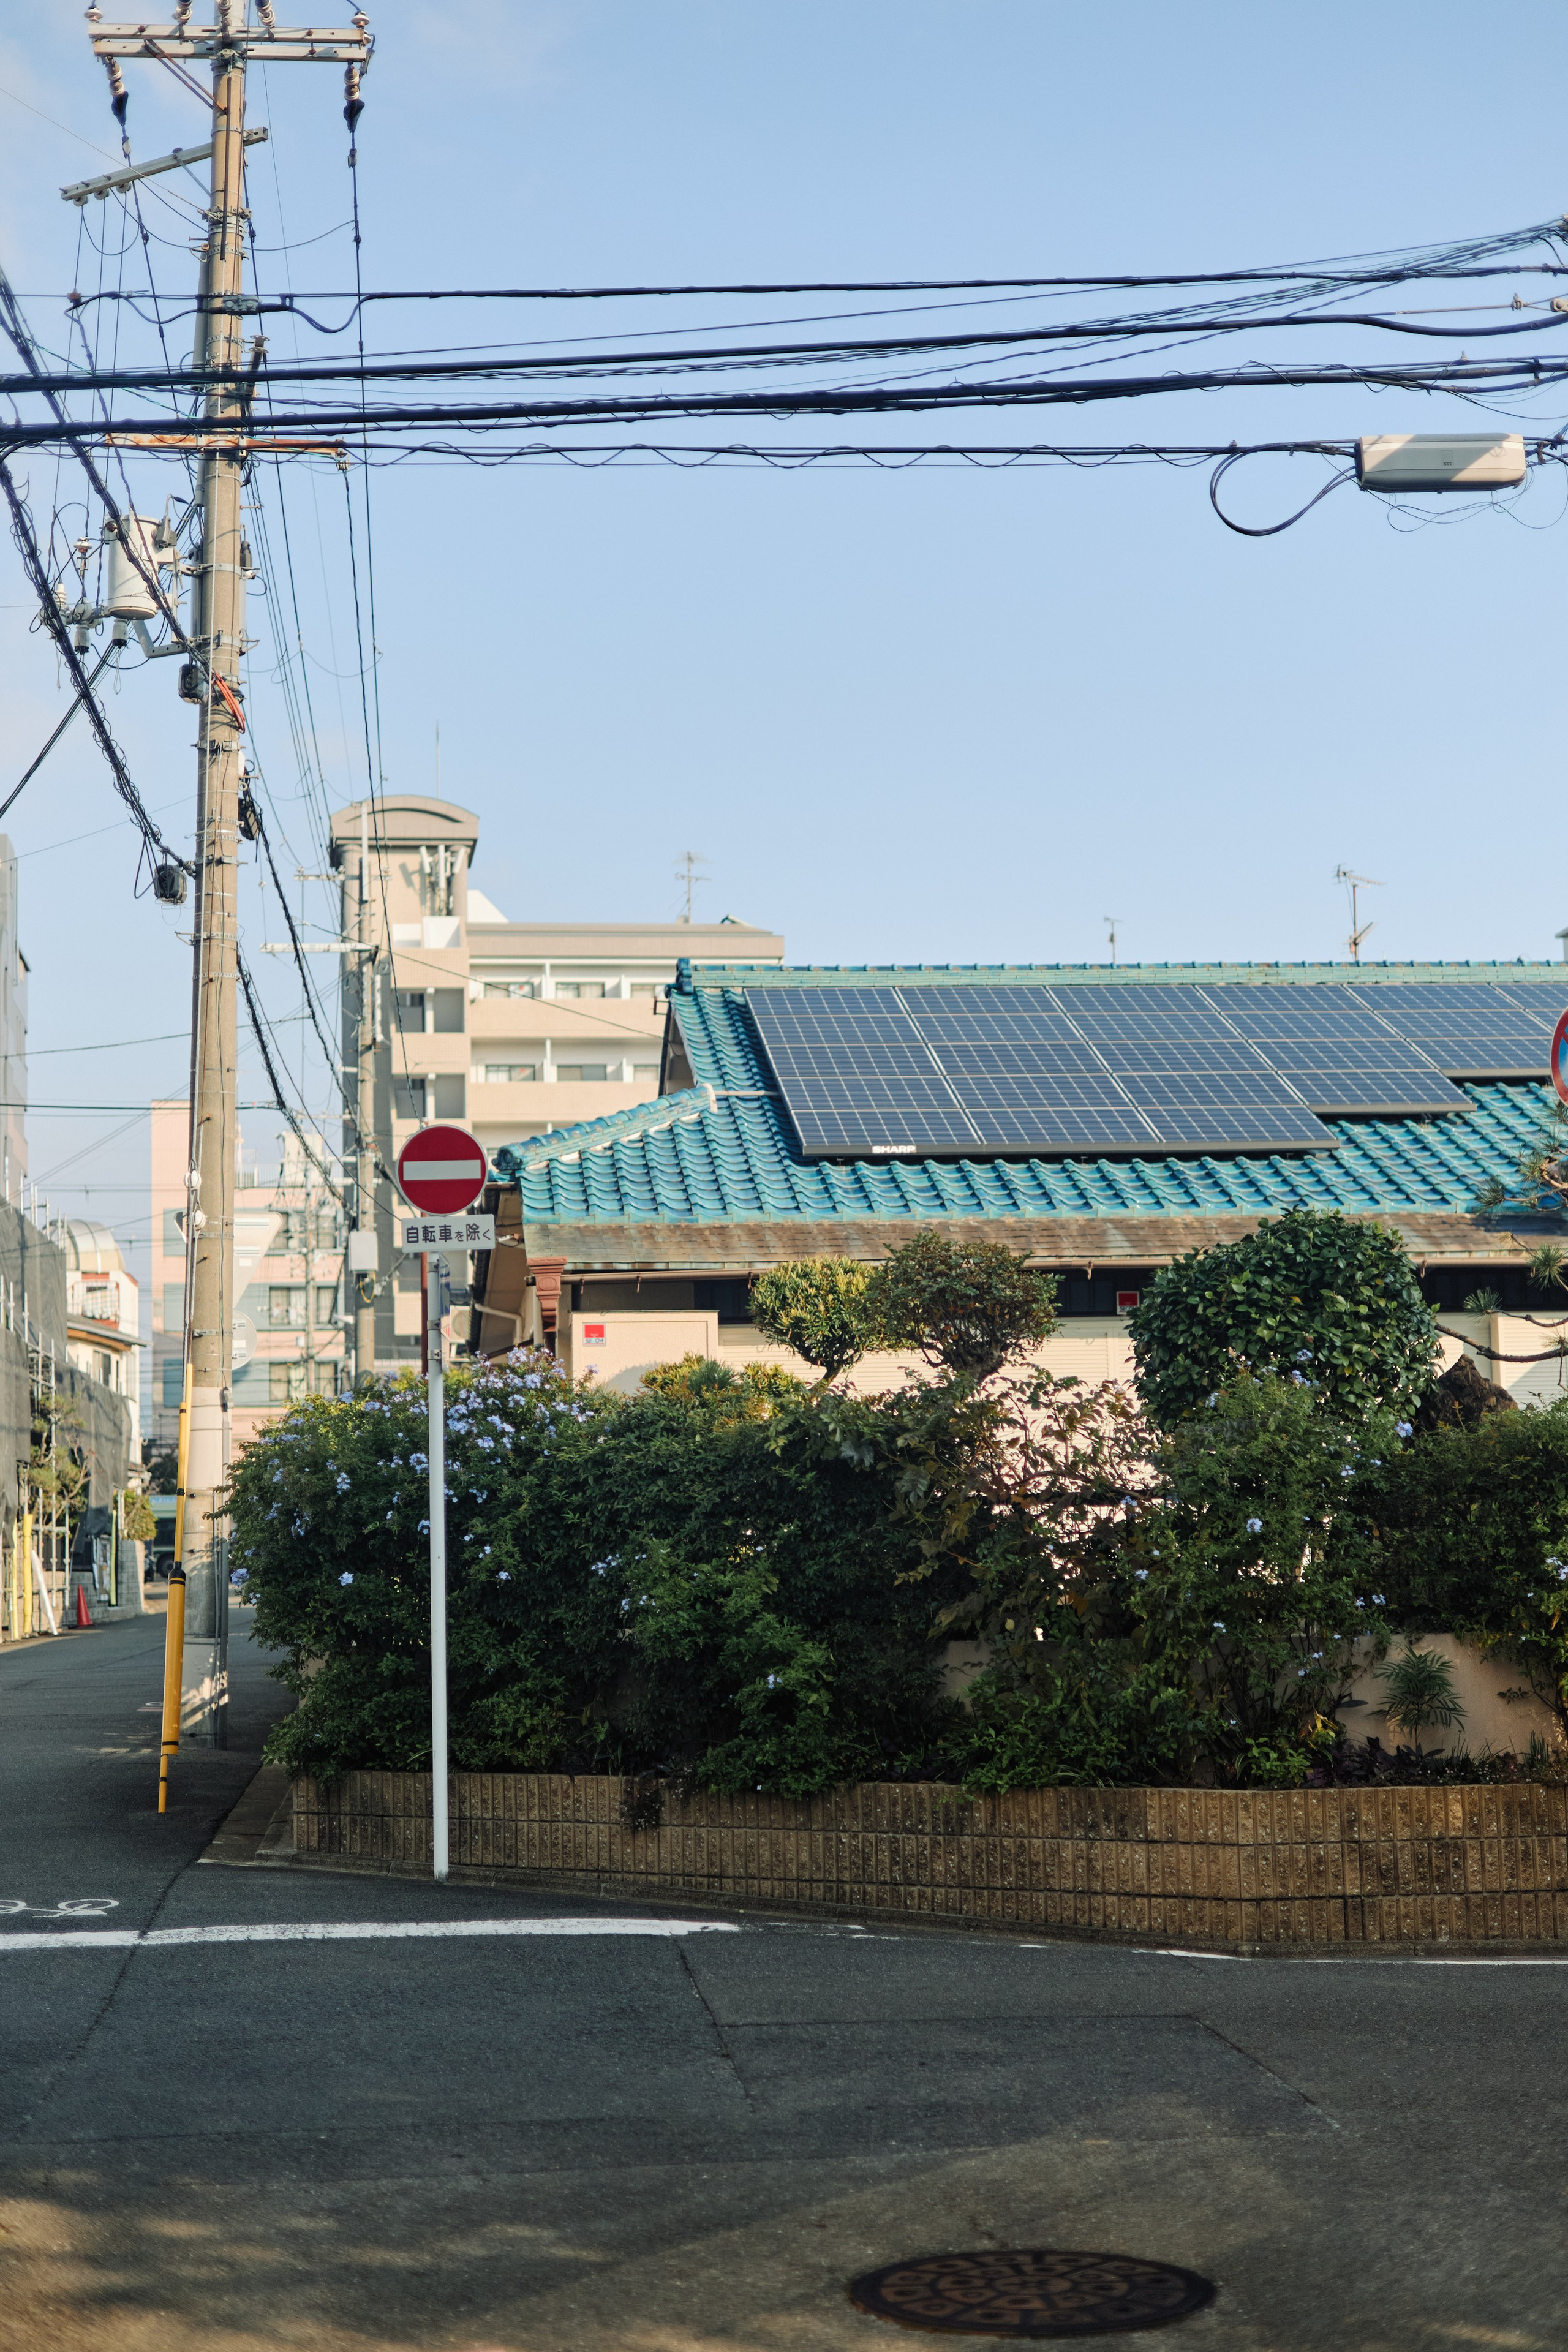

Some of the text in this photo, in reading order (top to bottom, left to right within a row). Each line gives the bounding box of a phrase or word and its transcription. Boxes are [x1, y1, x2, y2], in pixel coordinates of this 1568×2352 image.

[407, 1223, 491, 1243] 自転車を除く
